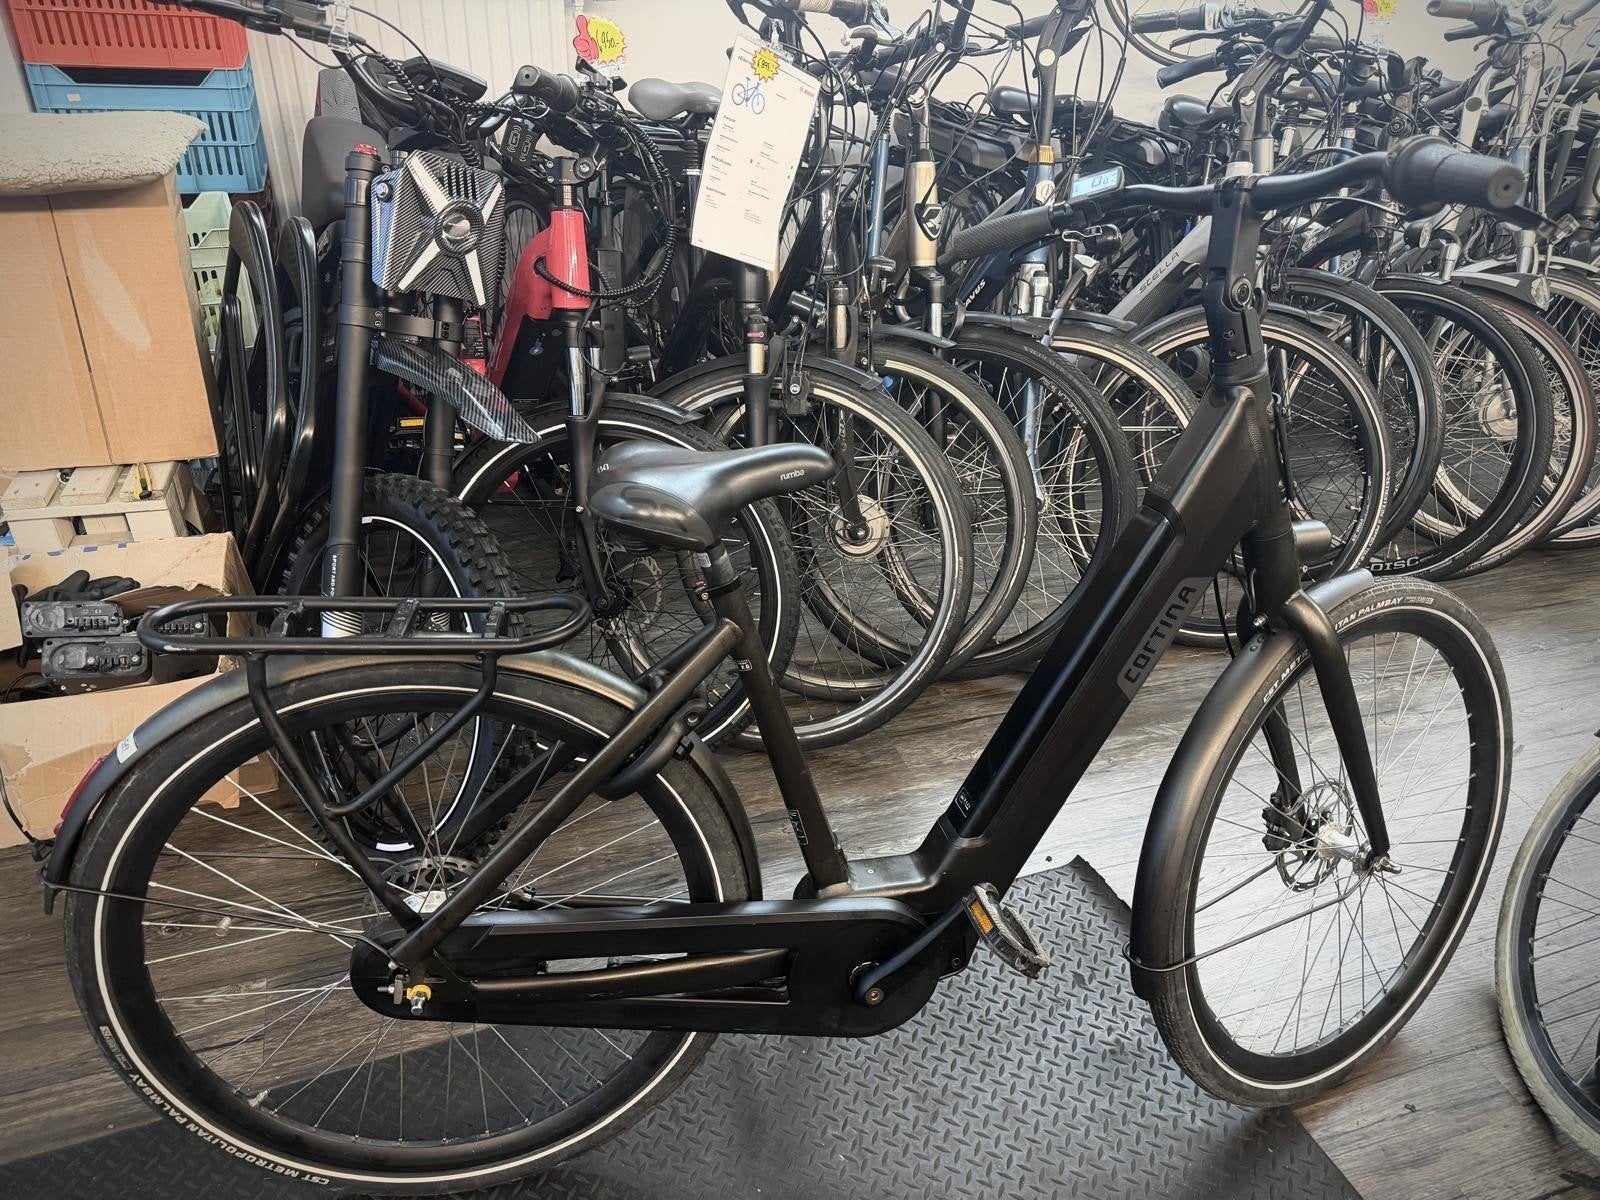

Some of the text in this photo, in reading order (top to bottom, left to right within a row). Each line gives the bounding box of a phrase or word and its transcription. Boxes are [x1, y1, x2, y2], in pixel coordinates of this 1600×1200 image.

[963, 278, 986, 308] AVUS
[780, 468, 805, 482] rumba
[1124, 586, 1197, 683] CORTINA
[1263, 680, 1280, 703] CST
[1357, 597, 1404, 616] PALMBAY
[128, 1073, 331, 1186] CST METROPOLITAN PALMBAY
